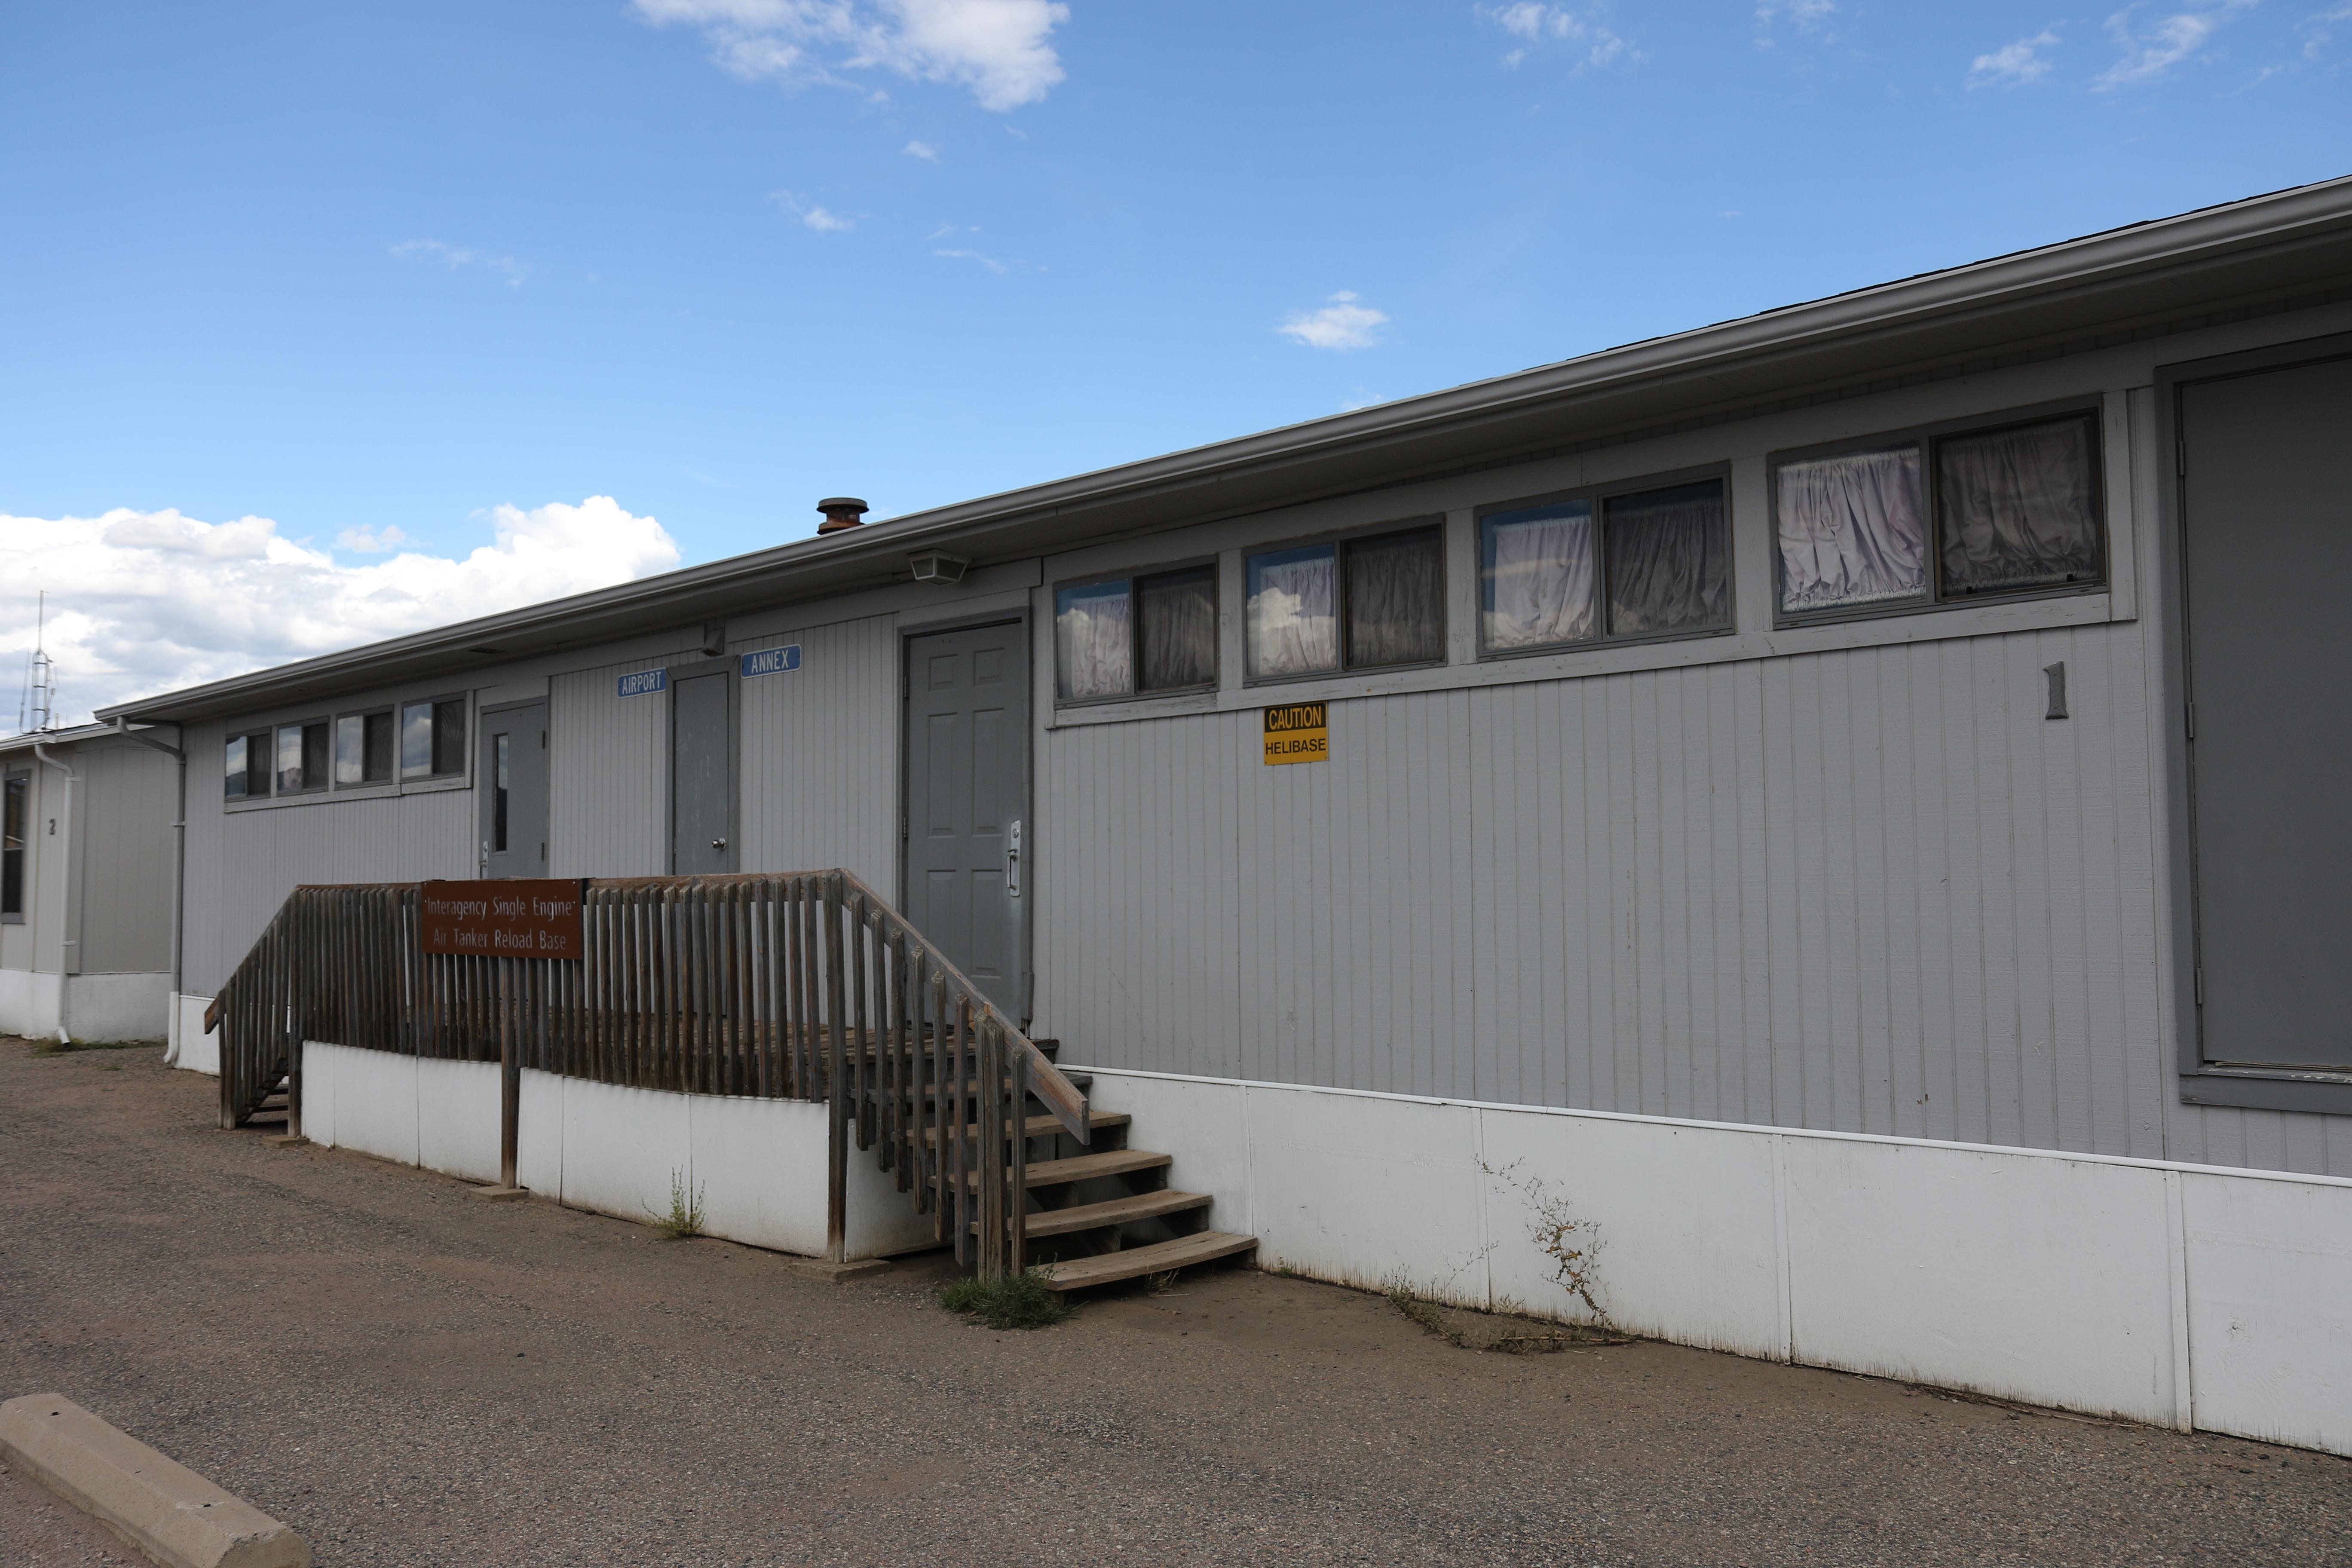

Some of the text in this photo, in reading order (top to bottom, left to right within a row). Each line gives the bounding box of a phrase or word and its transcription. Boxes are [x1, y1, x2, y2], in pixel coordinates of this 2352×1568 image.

[751, 650, 789, 673] ANNEX
[622, 671, 662, 695] AIRPORT
[2043, 661, 2069, 720] 1
[1269, 706, 1322, 730] CAUTION
[1265, 738, 1326, 755] HELIBASE
[49, 818, 56, 835] 2
[428, 896, 572, 922] Interagency Single Engine
[433, 927, 567, 950] Air Tanker Reload Base
